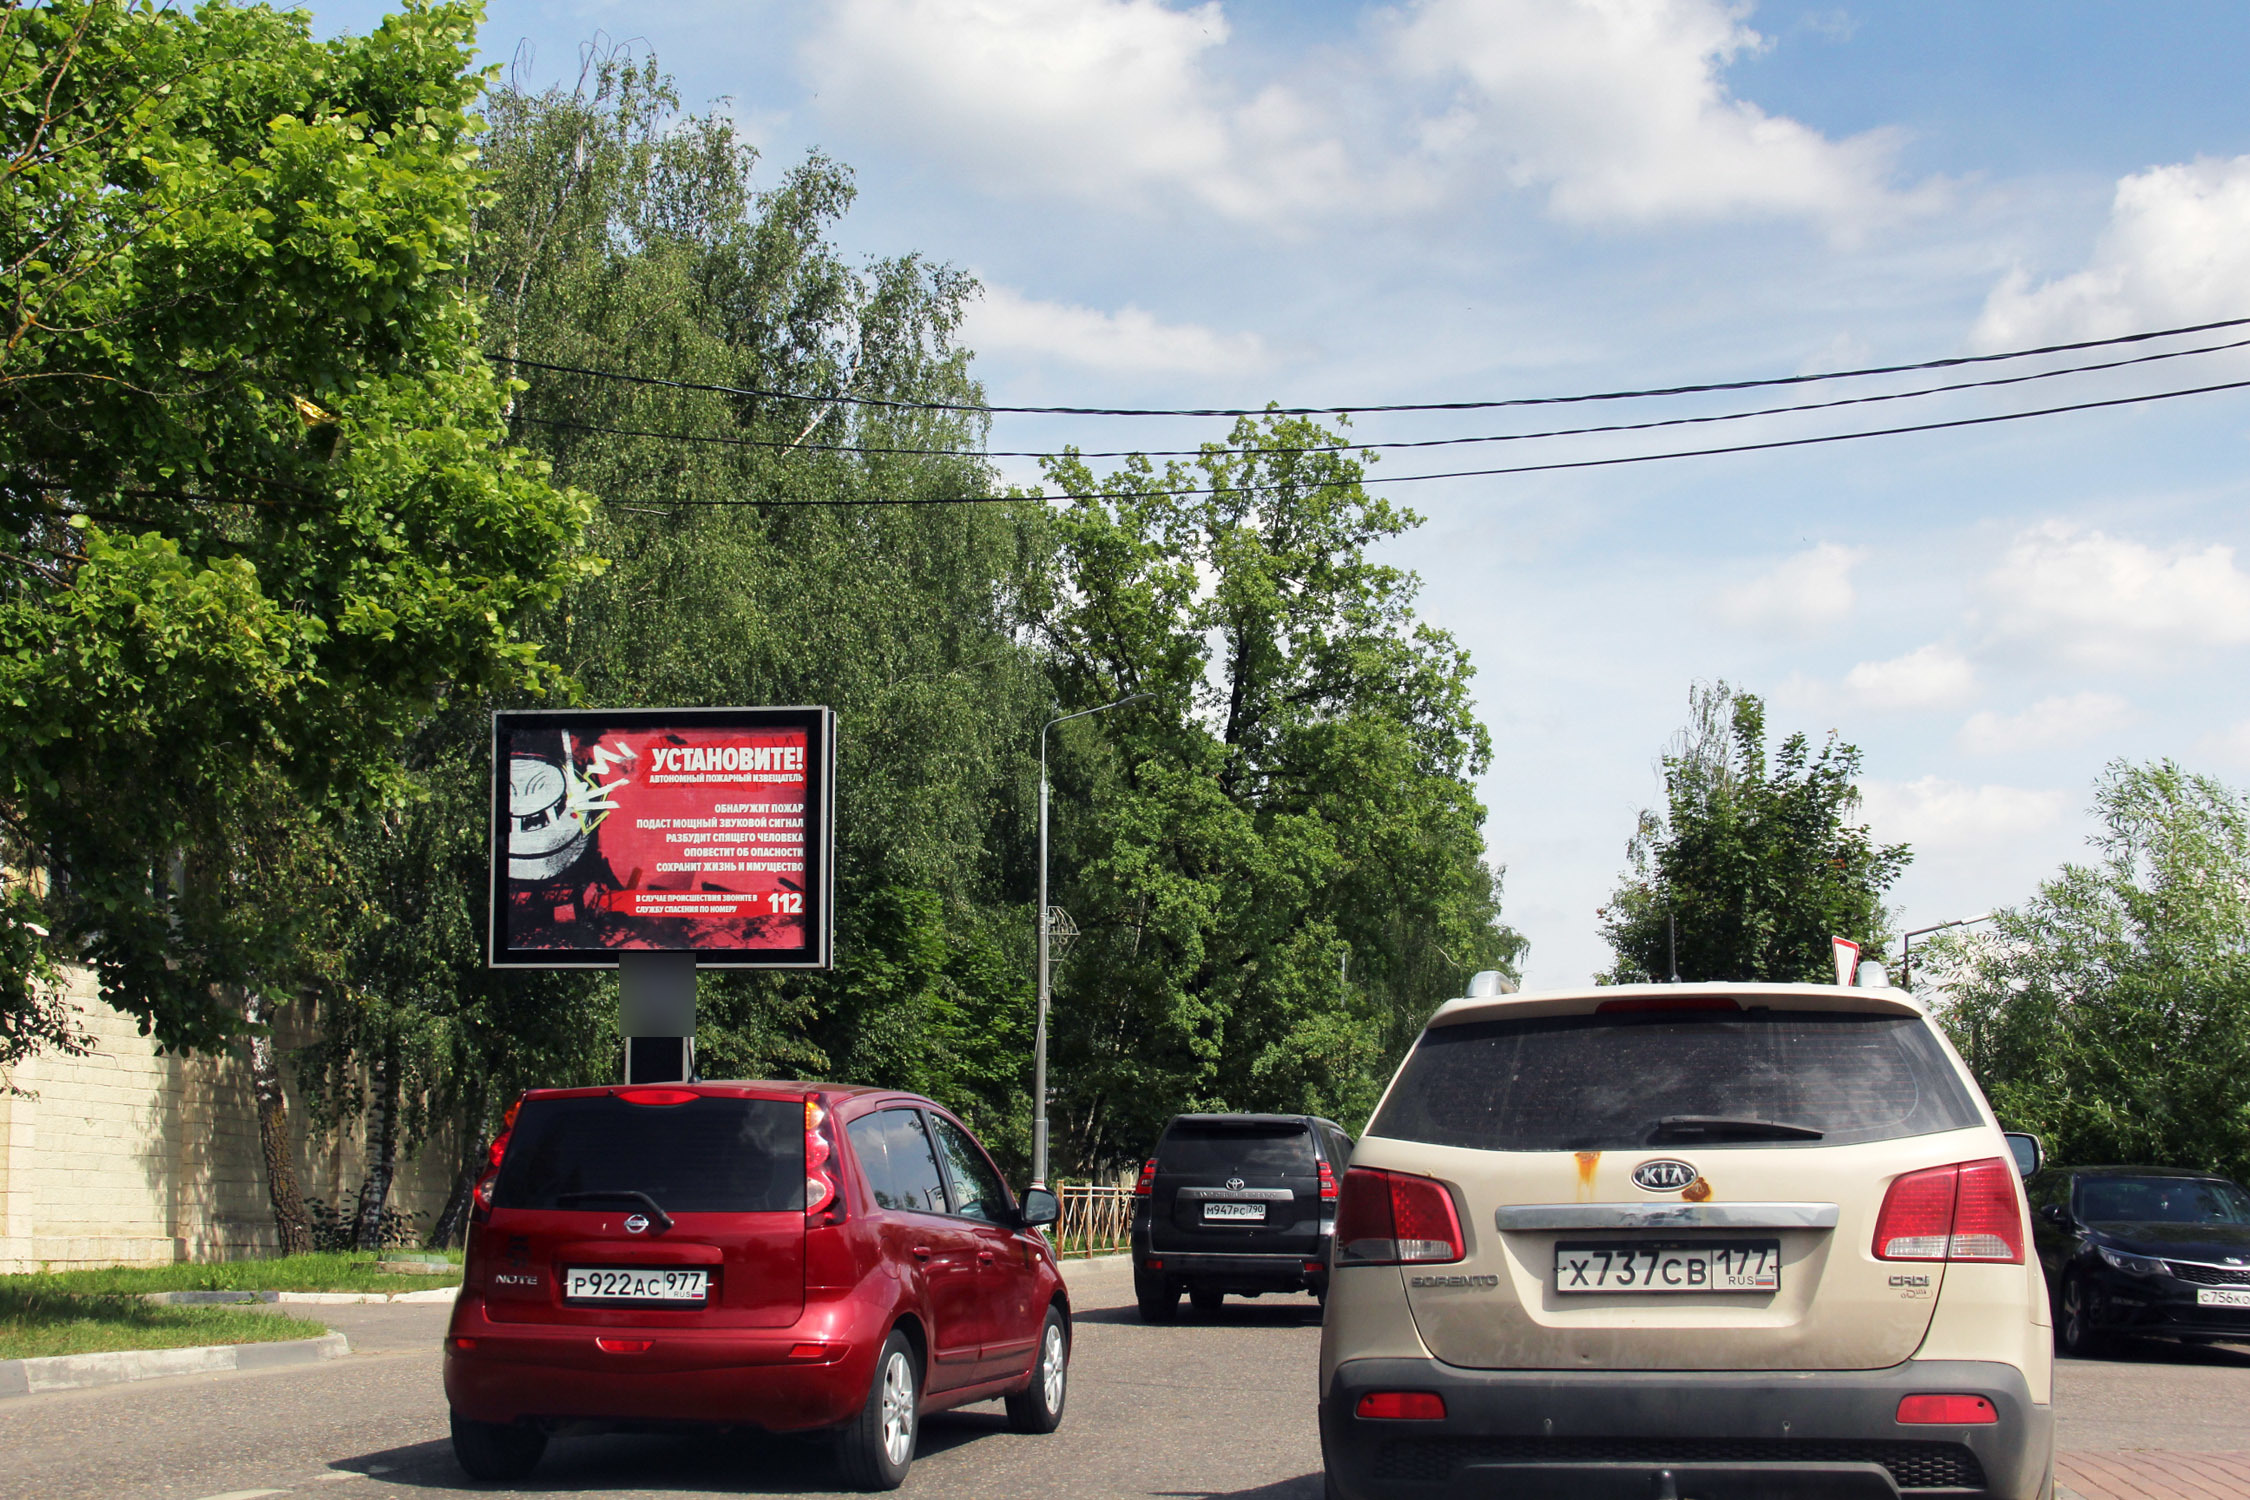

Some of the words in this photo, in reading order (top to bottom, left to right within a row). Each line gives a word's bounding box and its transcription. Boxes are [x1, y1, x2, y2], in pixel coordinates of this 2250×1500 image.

[651, 747, 804, 772] УСТАНОВИТЕ!
[649, 773, 705, 783] АВТОНОМНЫЙ
[706, 773, 751, 783] ПОЖАРНЫЙ
[753, 773, 804, 783] ИЗВЕЩАТЕЛЬ
[714, 804, 770, 813] ОБНАРУЖИТ
[771, 804, 804, 813] ПОЖАР
[636, 819, 671, 829] ПОДАСТ
[673, 817, 718, 829] МОЩНЫЙ
[719, 817, 767, 828] ЗВУКОВОЙ
[769, 818, 804, 828] СИГНАЛ
[666, 833, 711, 843] РАЗБУДИТ
[712, 833, 756, 843] СПЯЩЕГО
[757, 833, 804, 842] ЧЕЛОВЕКА
[684, 848, 735, 857] ОПОВЕСТИТ
[737, 848, 749, 857] ОБ
[751, 848, 804, 857] ОПАСНОСТИ
[656, 863, 702, 872] СОХРАНИТ
[703, 863, 737, 872] ЖИЗНЬ
[738, 863, 745, 871] И
[746, 863, 804, 872] ИМУЩЕСТВО
[722, 894, 752, 902] ЗВОНИТЕ
[752, 894, 758, 902] В
[768, 893, 803, 914] 112
[664, 905, 699, 913] СПАСЕНИЯ
[699, 905, 709, 913] ПО
[710, 905, 738, 913] НОМЕРУ
[1641, 1167, 1686, 1184] KIA
[1248, 1205, 1263, 1213] 790
[1569, 1250, 1707, 1286] Х737СВ
[1716, 1249, 1768, 1275] 177
[495, 1274, 538, 1285] NOTE
[574, 1272, 660, 1296] Р922АС
[666, 1272, 701, 1290] 977
[1410, 1275, 1499, 1288] SORENTO
[1728, 1275, 1754, 1285] RUS
